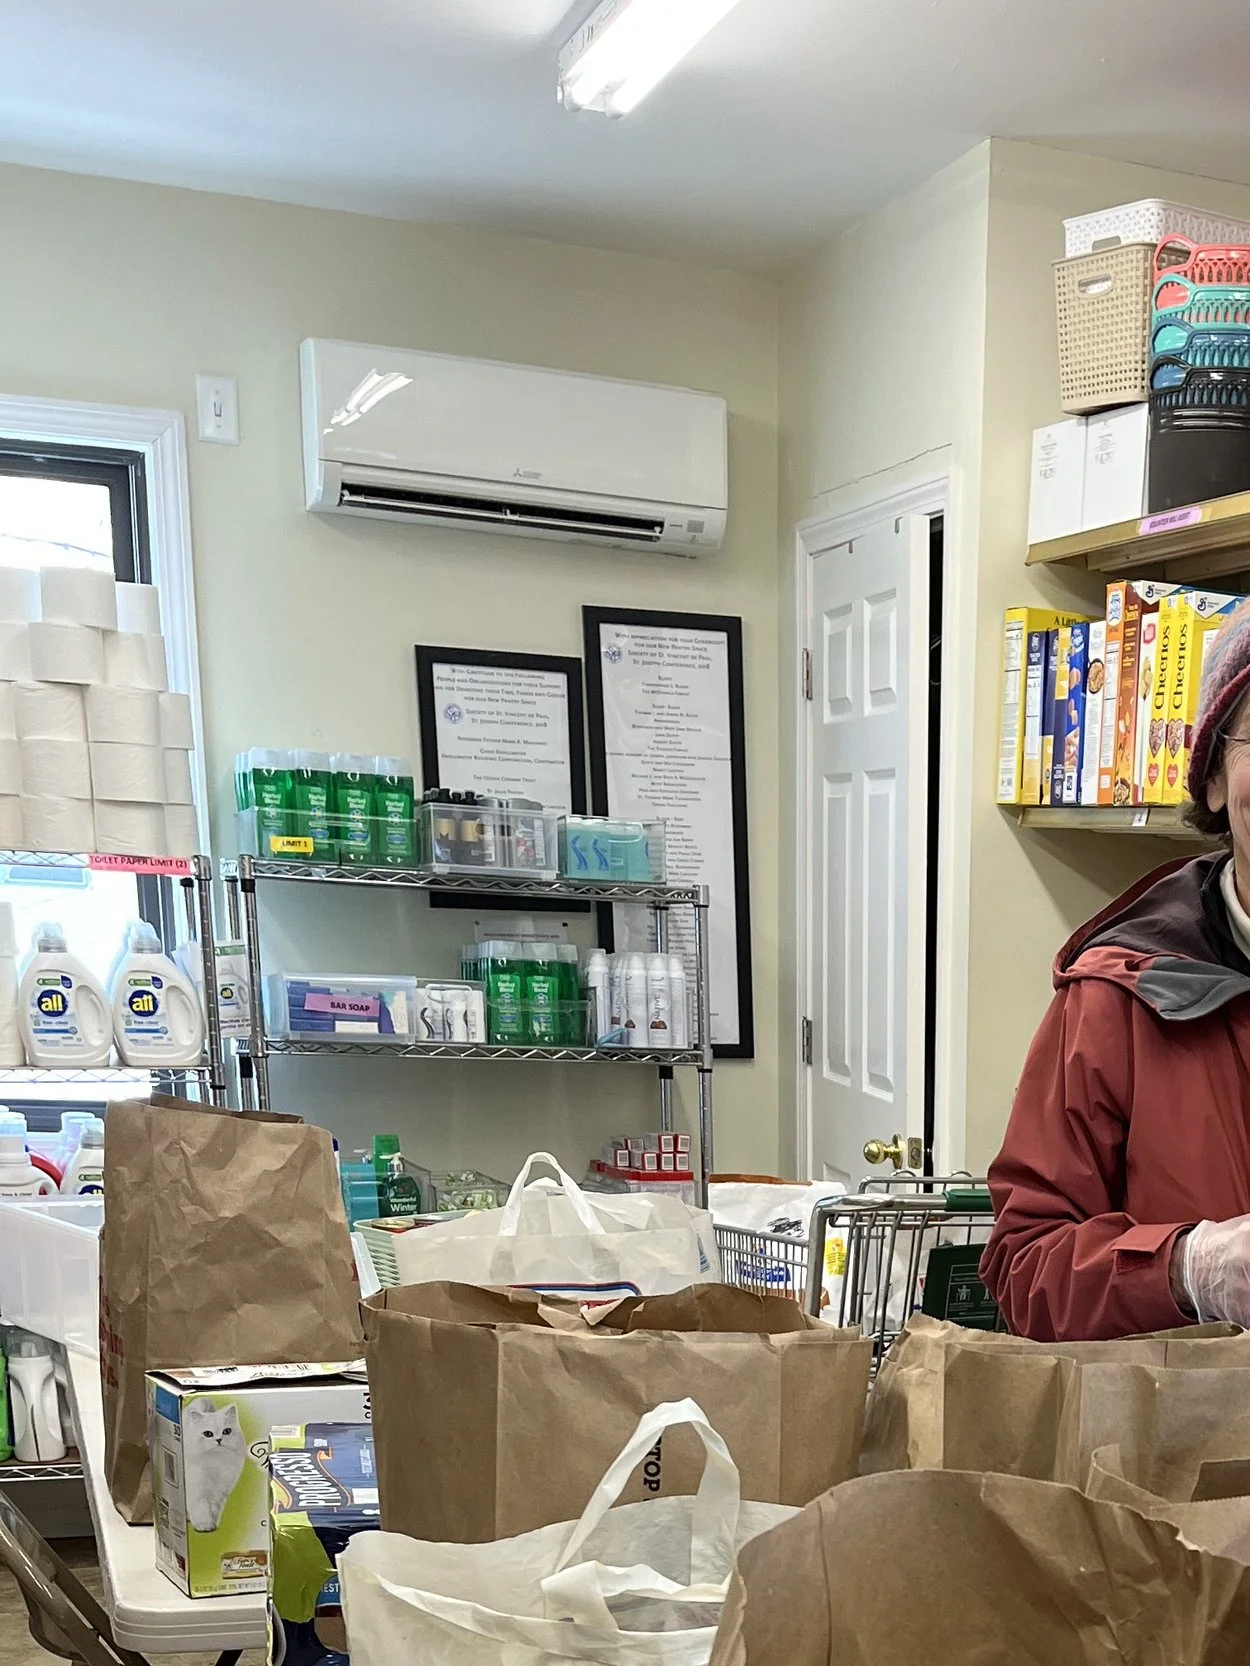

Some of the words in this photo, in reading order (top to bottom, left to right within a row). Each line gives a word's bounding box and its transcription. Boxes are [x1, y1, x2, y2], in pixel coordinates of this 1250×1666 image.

[1154, 625, 1171, 710] Cheerios
[1173, 624, 1188, 710] Cheerios
[90, 855, 118, 866] TOILET
[121, 857, 149, 866] PAPER
[150, 858, 173, 867] LIMIT
[176, 860, 187, 869] (2)
[40, 996, 63, 1012] all
[131, 996, 153, 1012] all
[330, 1001, 347, 1010] BAR
[348, 1003, 370, 1012] SOAP
[390, 1203, 418, 1212] Winter
[643, 1436, 662, 1492] TOP
[271, 1452, 341, 1507] PROGRESSO
